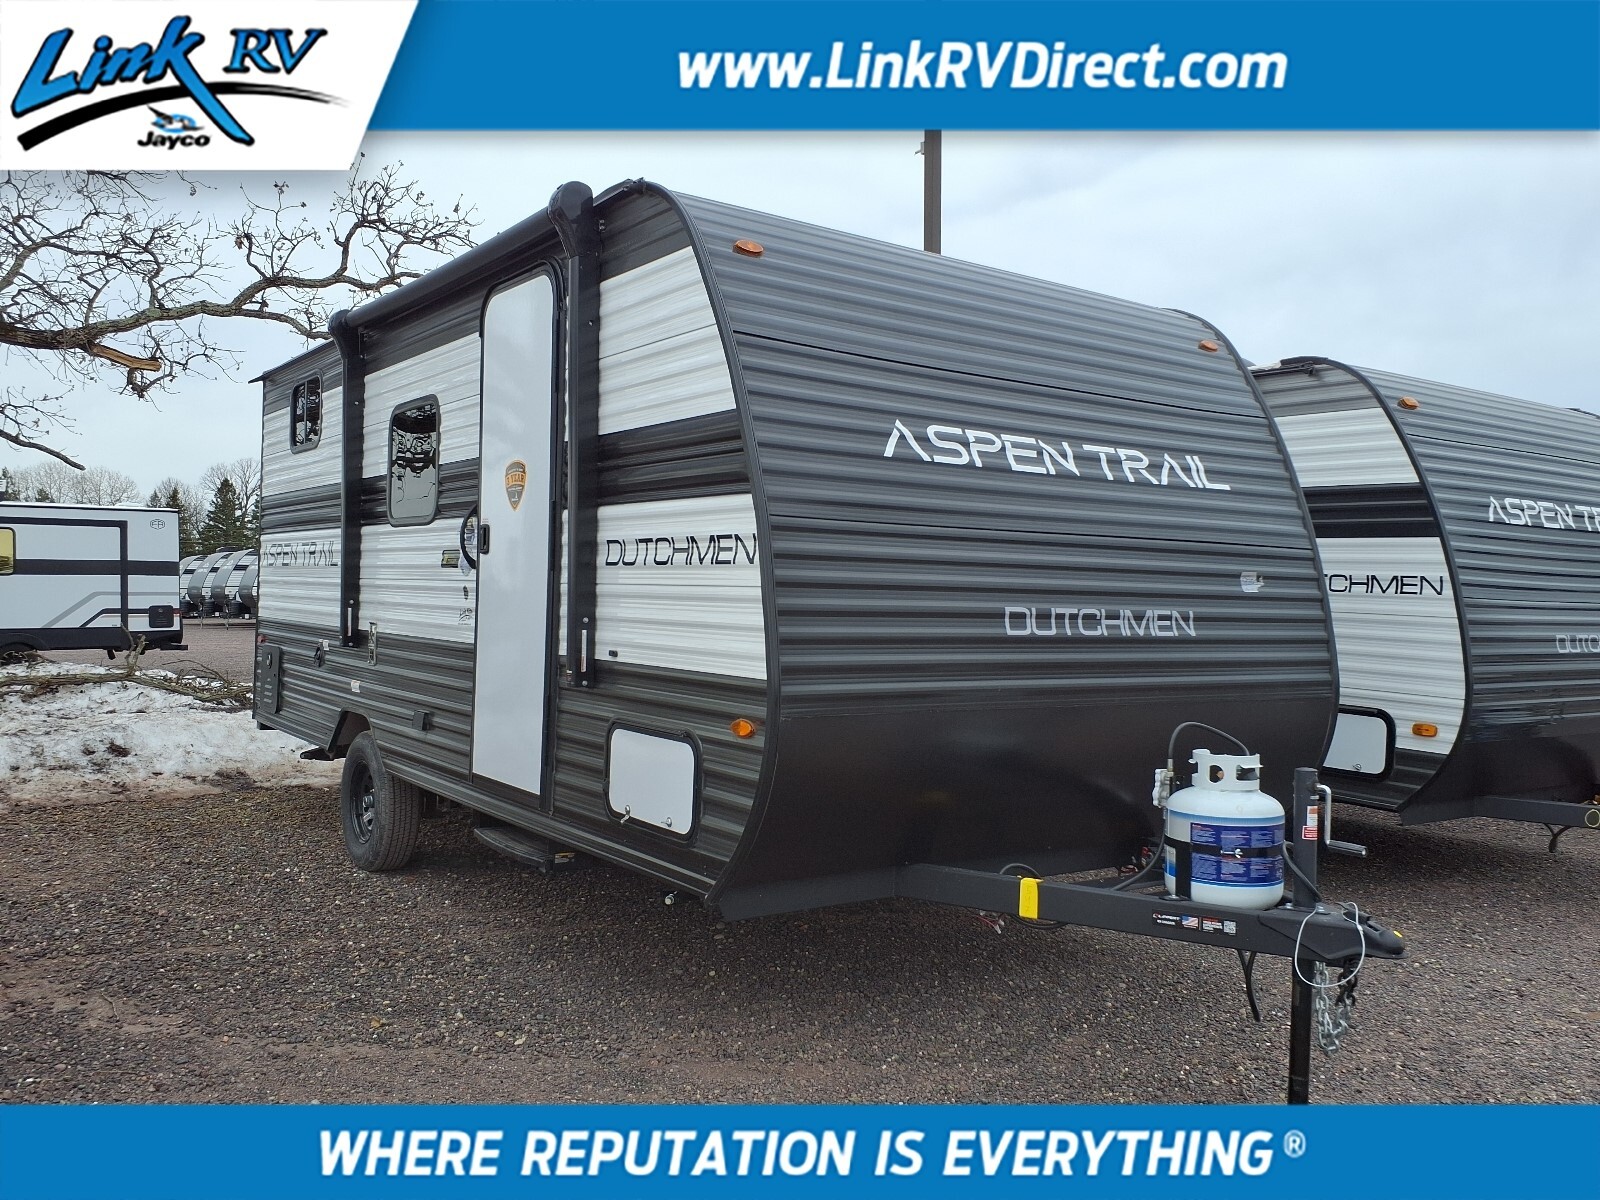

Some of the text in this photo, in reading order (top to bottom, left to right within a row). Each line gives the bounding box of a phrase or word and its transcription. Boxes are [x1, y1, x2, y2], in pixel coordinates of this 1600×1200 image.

[883, 418, 1232, 491] ASPEN TRAIL
[1488, 495, 1576, 530] ASPEN
[604, 532, 757, 567] DUTCHMEN
[1323, 573, 1444, 596] CHMEN
[1003, 606, 1197, 637] DUTCHMEN
